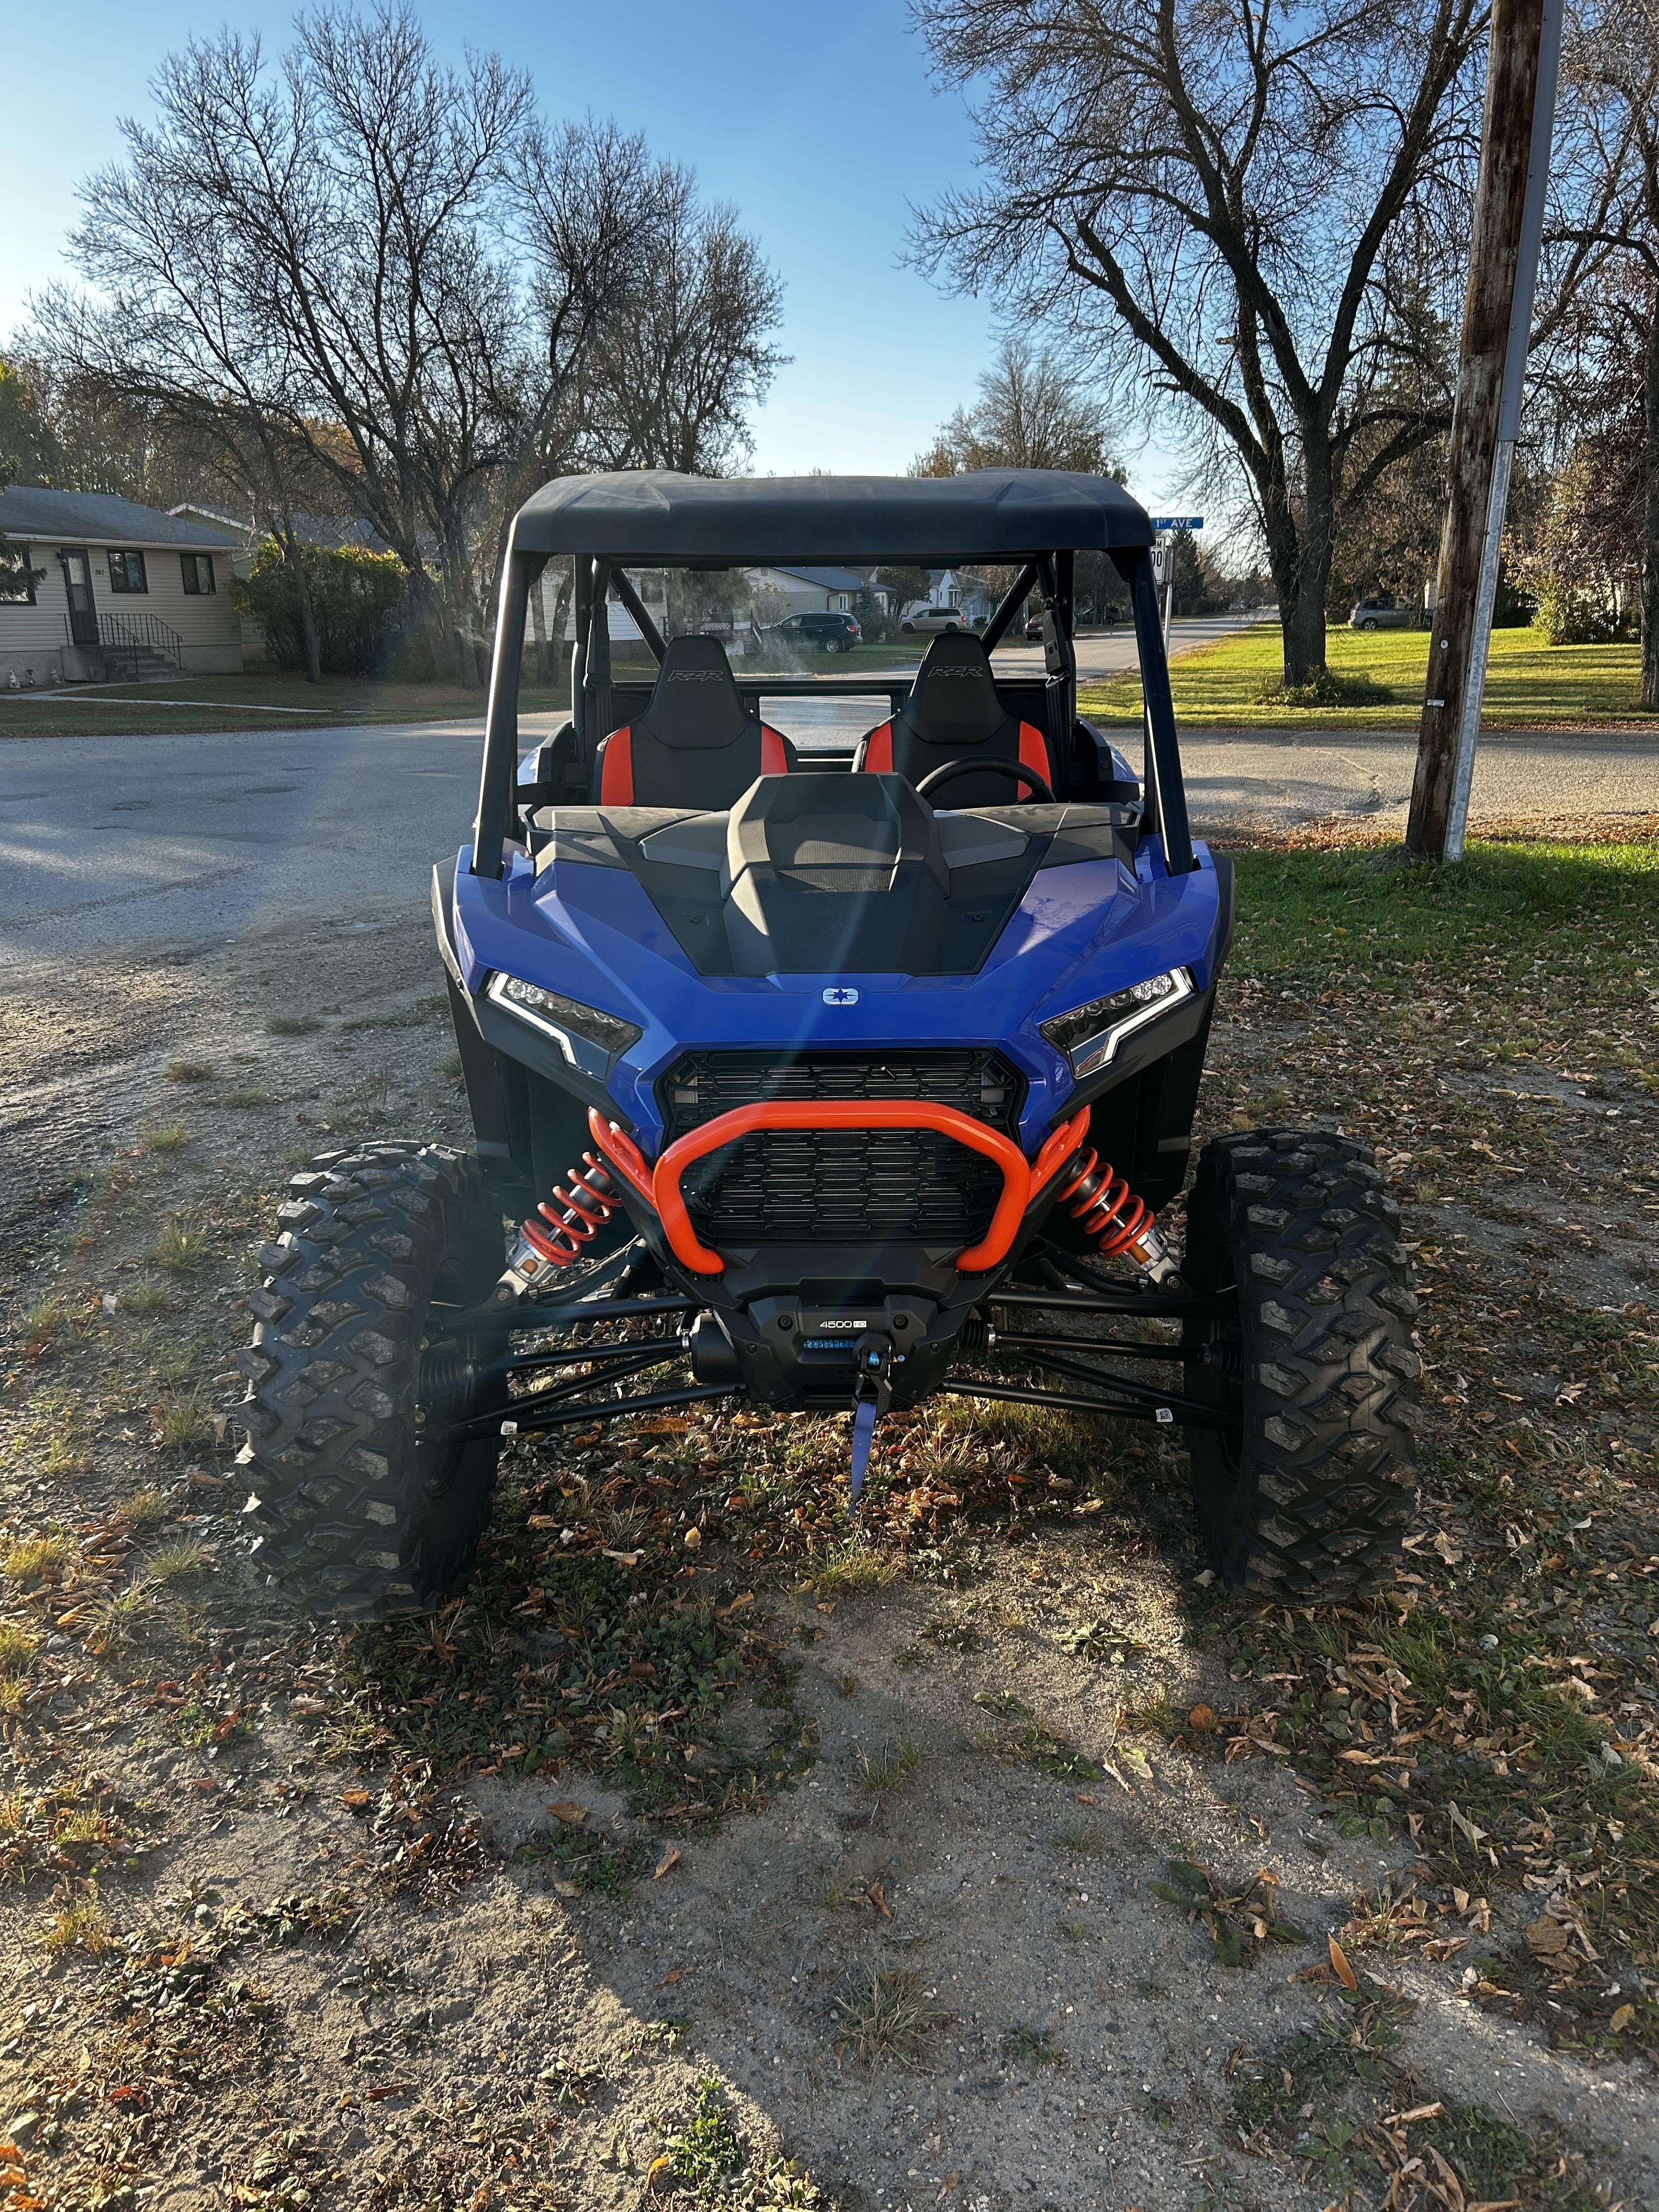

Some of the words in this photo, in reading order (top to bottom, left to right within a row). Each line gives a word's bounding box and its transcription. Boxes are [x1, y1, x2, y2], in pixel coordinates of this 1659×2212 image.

[1156, 519, 1167, 528] 1ST
[1170, 518, 1193, 528] AVE
[667, 670, 724, 681] RZR
[927, 666, 983, 678] RZR
